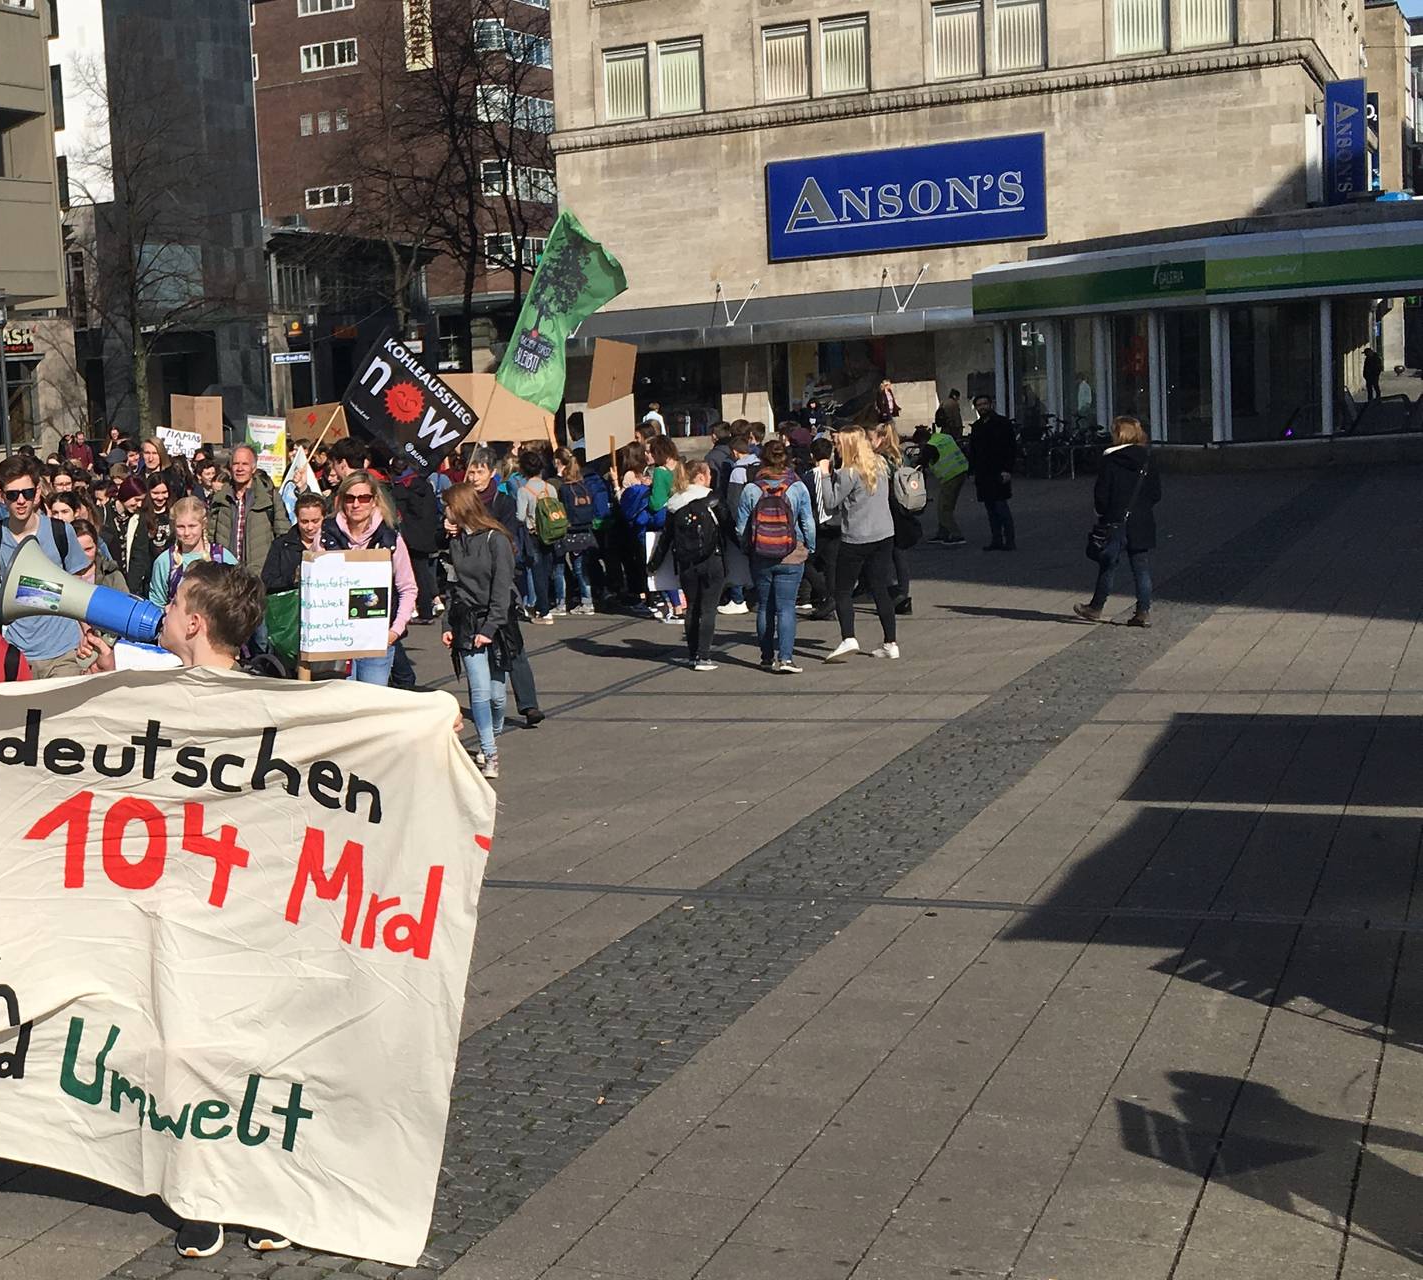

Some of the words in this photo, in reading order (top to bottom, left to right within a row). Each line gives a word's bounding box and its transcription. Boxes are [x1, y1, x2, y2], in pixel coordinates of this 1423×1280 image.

[785, 169, 1025, 233] ANSON'S
[383, 337, 472, 426] KOHLEAUSSTIEG
[24, 790, 250, 908] 104
[285, 826, 444, 960] Mrd
[59, 1016, 314, 1152] Umwelt
